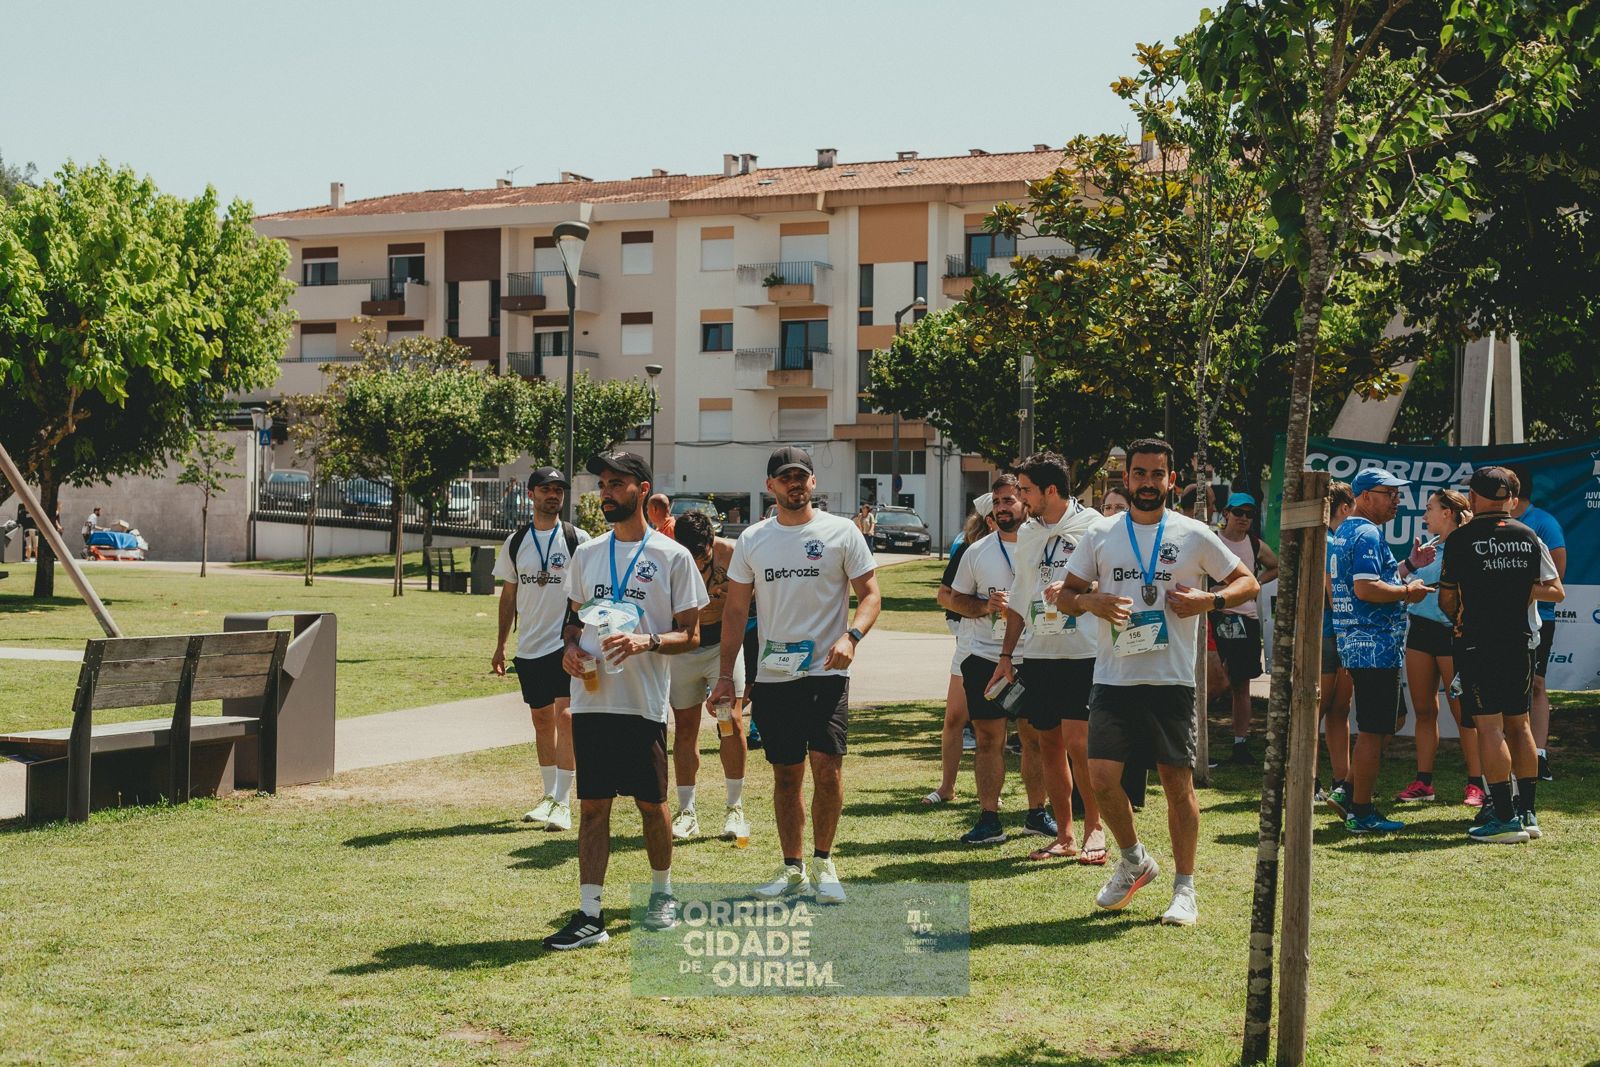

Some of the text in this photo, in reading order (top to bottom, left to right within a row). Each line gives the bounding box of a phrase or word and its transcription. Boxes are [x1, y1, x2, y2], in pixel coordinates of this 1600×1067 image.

[1584, 492, 1600, 500] JUV
[1472, 537, 1533, 556] Thomar
[1482, 557, 1528, 571] Athletics
[520, 574, 562, 585] Retzis
[765, 566, 820, 582] Retrozis
[1113, 568, 1172, 581] Retrzis
[1555, 609, 1577, 619] RÉM
[1129, 631, 1142, 639] 156
[1548, 652, 1574, 664] ial
